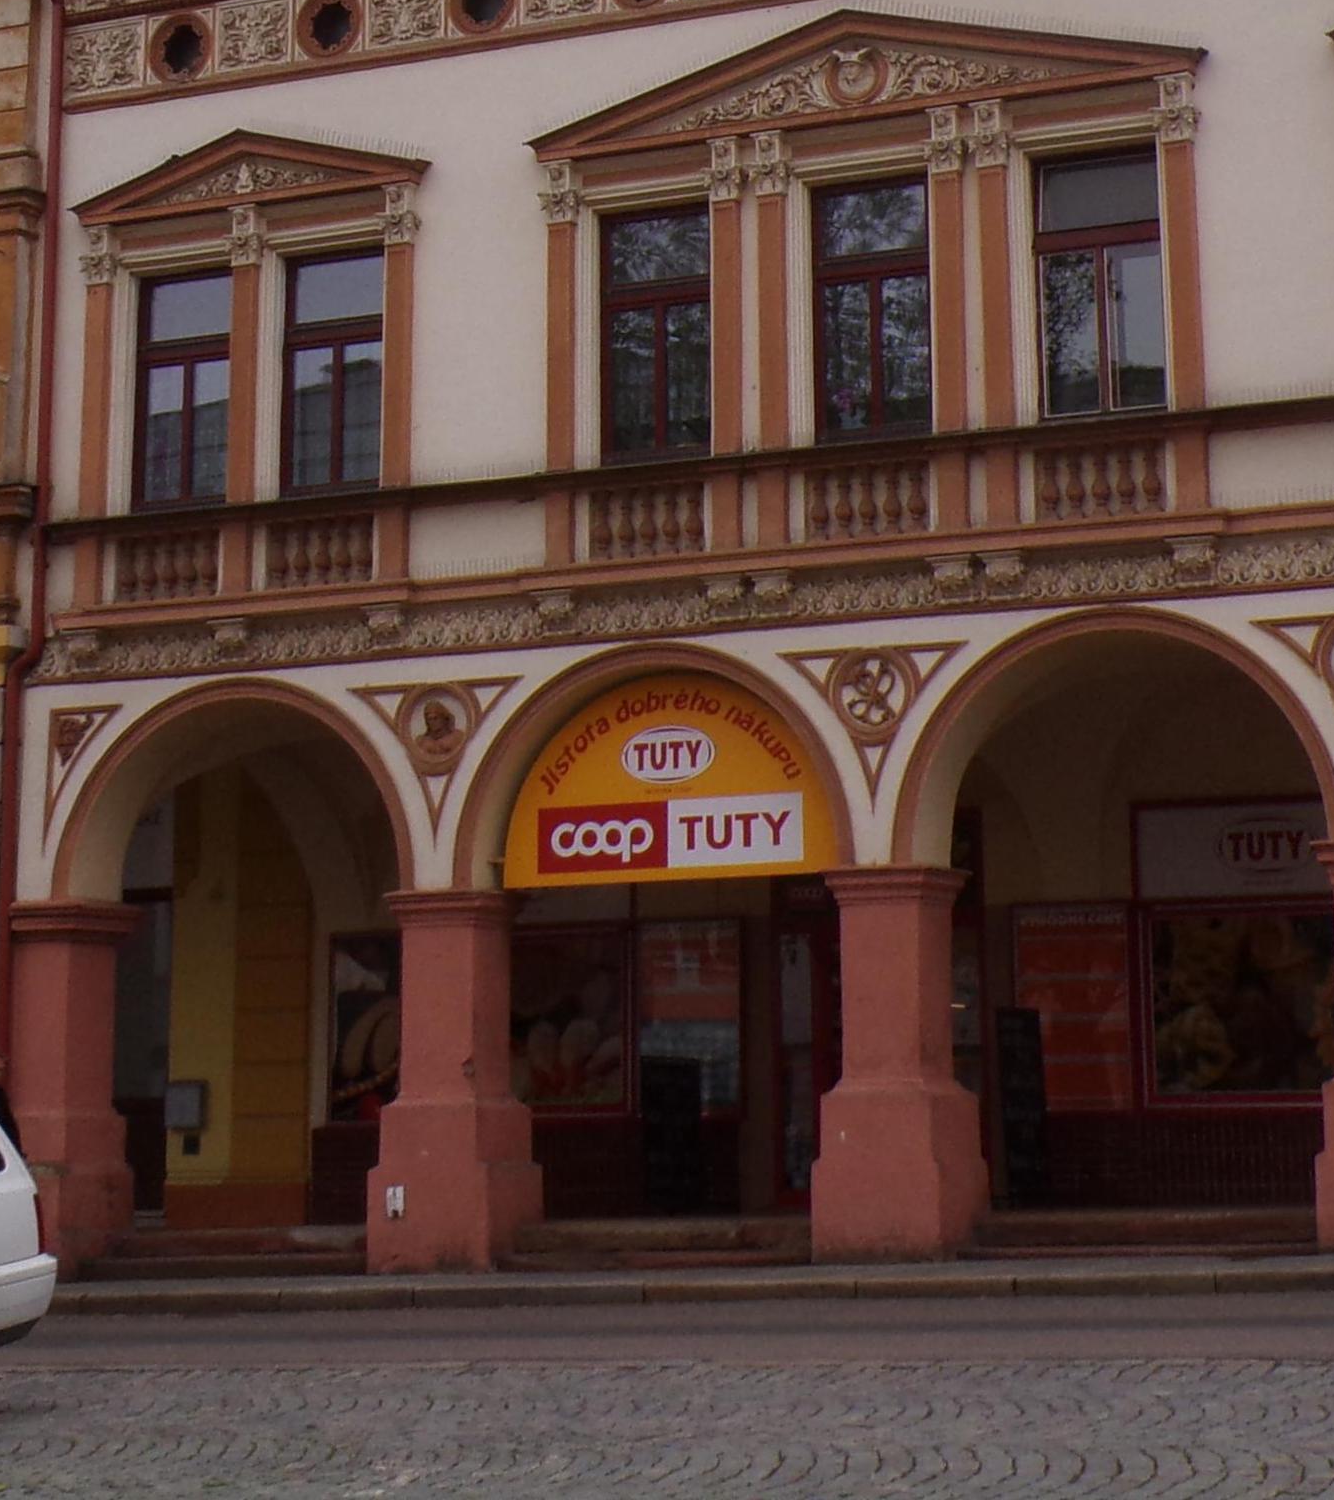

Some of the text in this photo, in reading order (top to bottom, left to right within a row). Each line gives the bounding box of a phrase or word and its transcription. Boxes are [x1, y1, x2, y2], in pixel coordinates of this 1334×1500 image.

[539, 689, 802, 796] Jistota dobrého nákupu
[633, 739, 702, 772] TUTY
[679, 810, 791, 851] TUTY
[1227, 830, 1304, 862] TUTY
